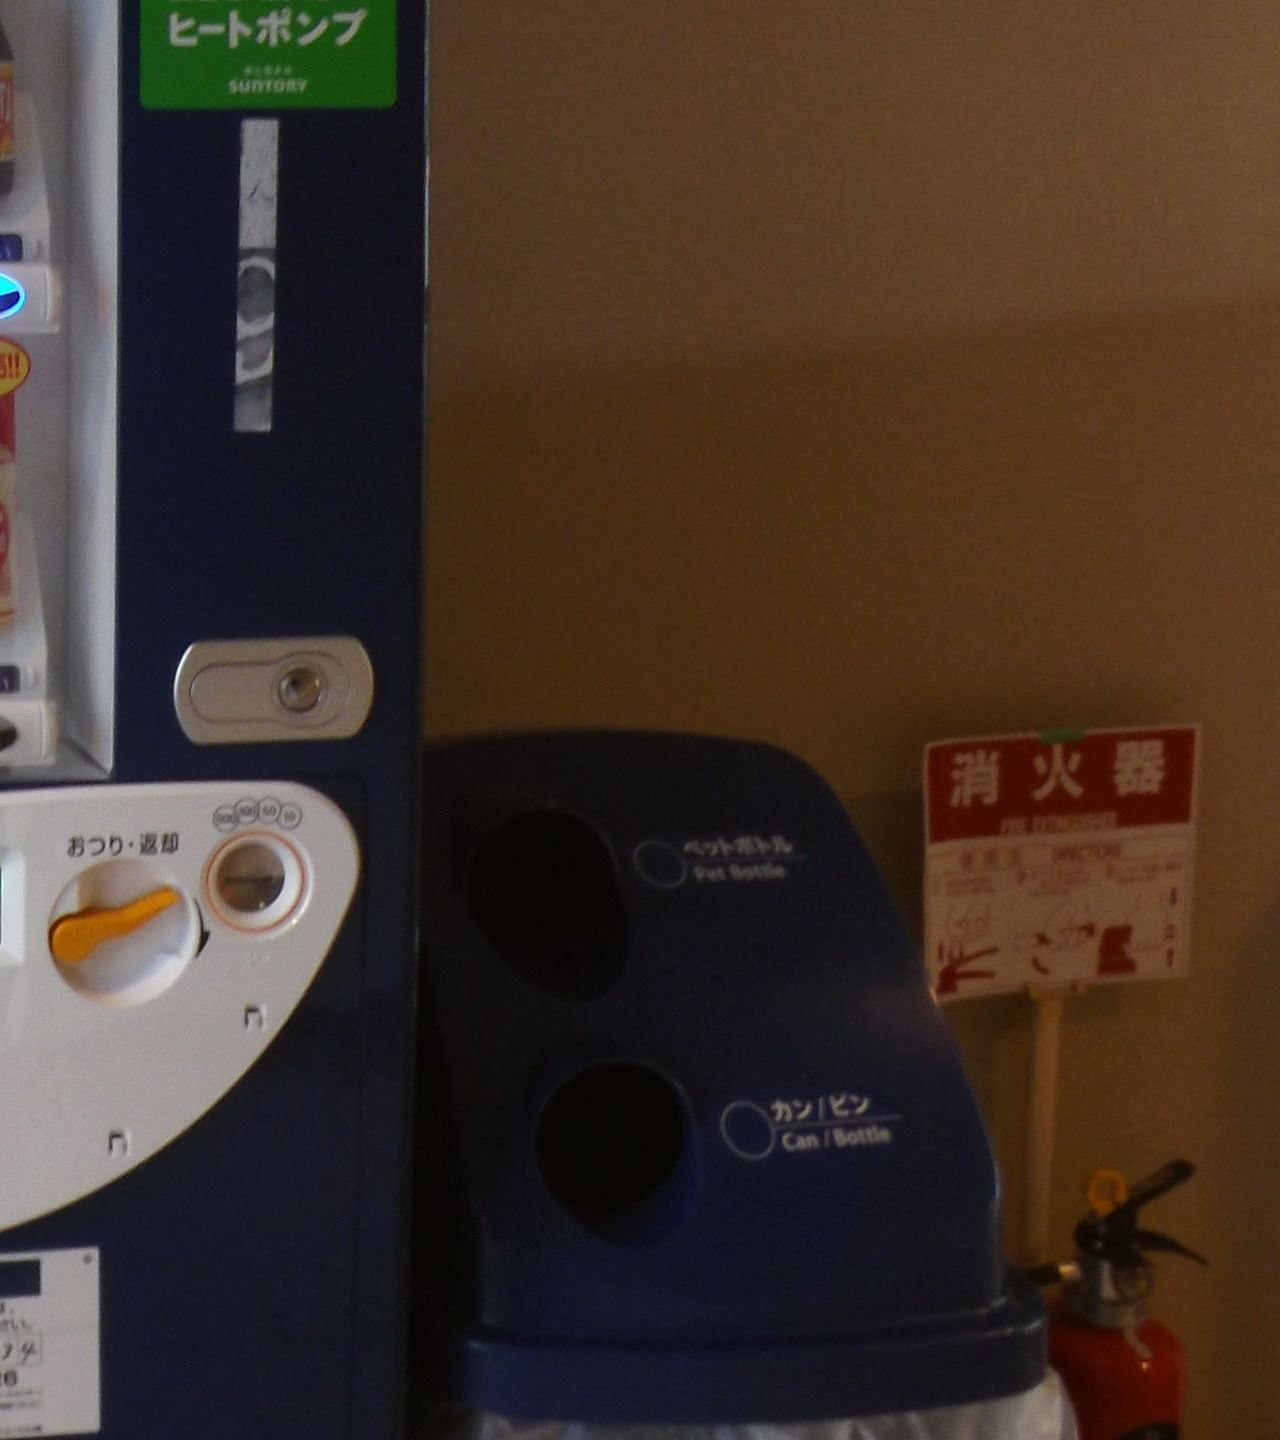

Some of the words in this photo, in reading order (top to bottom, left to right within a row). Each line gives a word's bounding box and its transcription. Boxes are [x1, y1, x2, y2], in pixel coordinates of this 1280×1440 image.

[168, 6, 369, 50] ヒートポンプ
[227, 78, 309, 95] SUNTORY
[949, 738, 1166, 808] 消火器
[66, 831, 181, 858] おつり・返却
[781, 1130, 820, 1153] Can
[831, 1125, 892, 1148] Bottle
